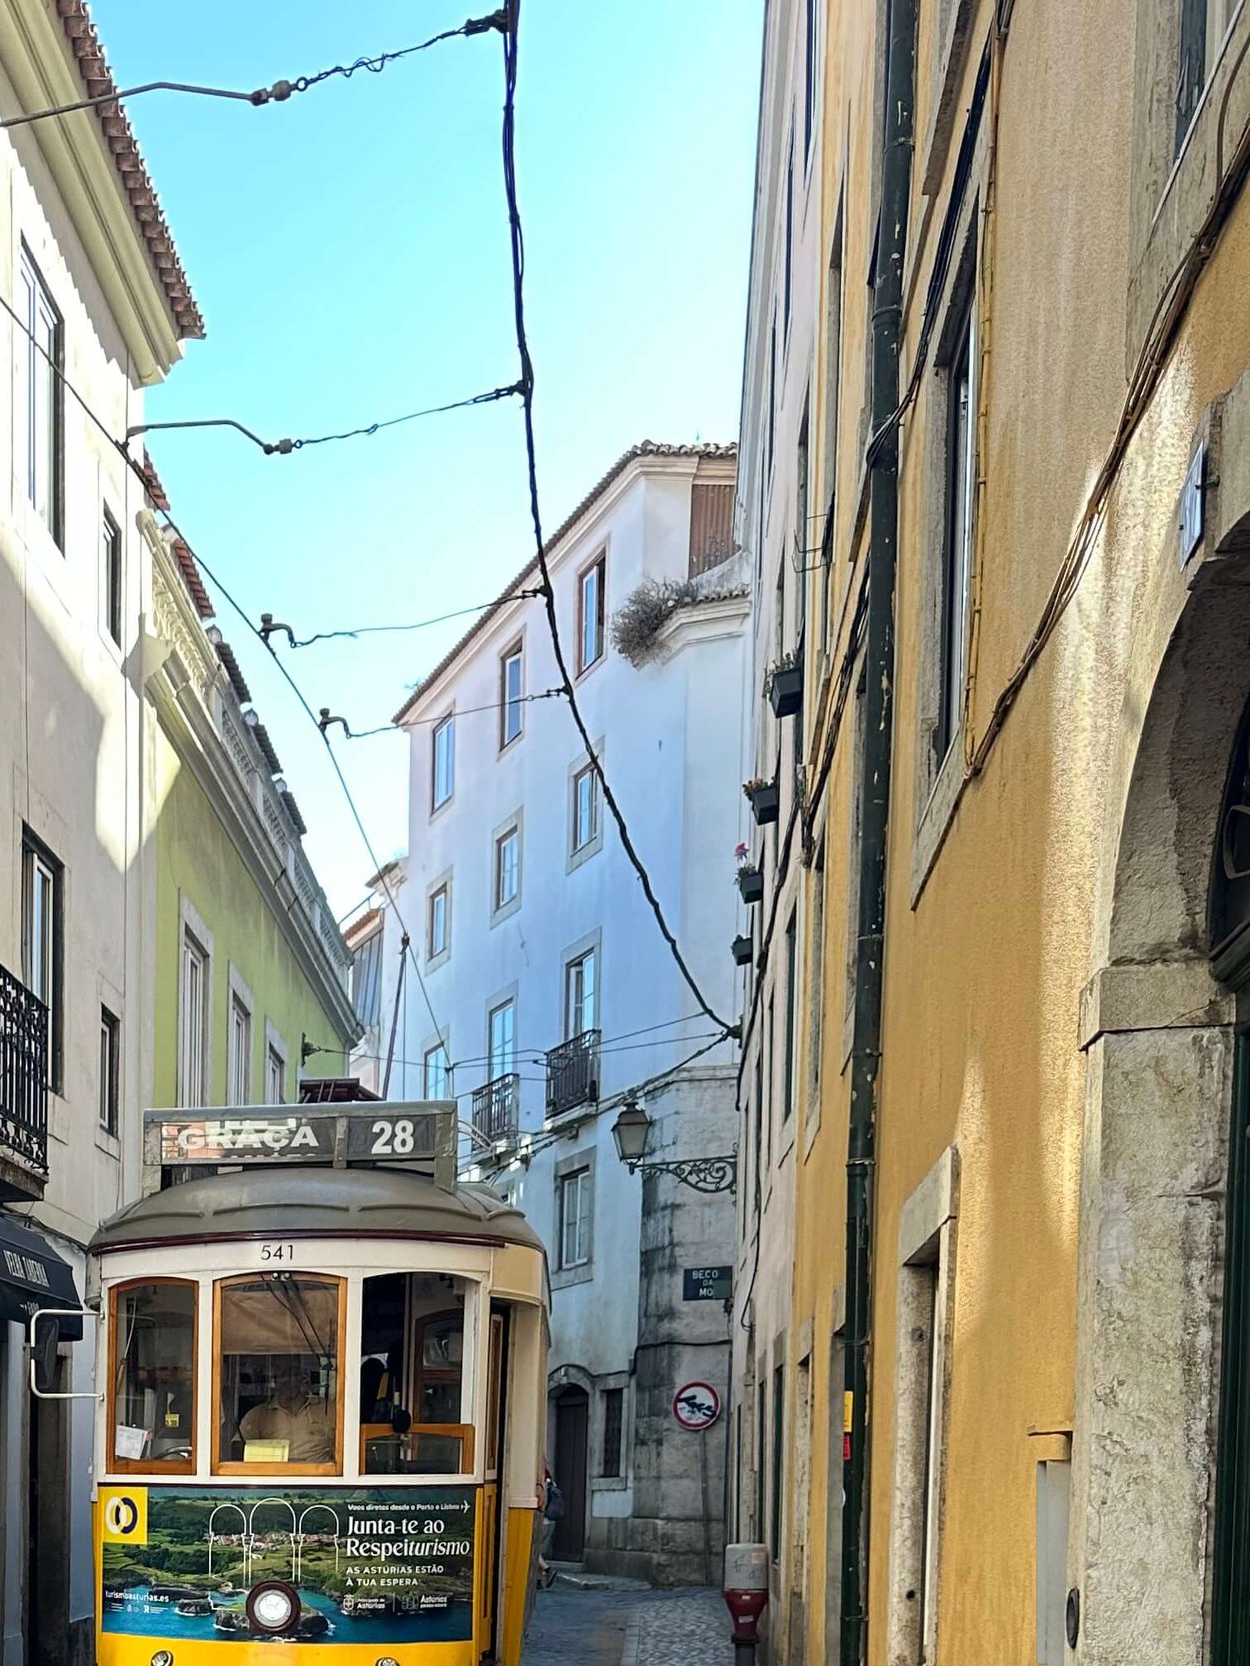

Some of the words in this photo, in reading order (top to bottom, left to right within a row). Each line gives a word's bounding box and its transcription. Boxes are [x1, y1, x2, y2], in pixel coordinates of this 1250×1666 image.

[177, 1125, 320, 1151] GRAÇA
[371, 1120, 415, 1155] 28
[260, 1244, 294, 1261] 541
[692, 1269, 719, 1280] BECO
[348, 1516, 419, 1535] Junta-te
[423, 1519, 445, 1534] ao
[346, 1538, 470, 1561] Respeiturismo
[346, 1566, 360, 1575] AS
[415, 1563, 444, 1574] ESTÃO
[356, 1578, 377, 1586] TUA
[380, 1578, 419, 1586] ESPERA
